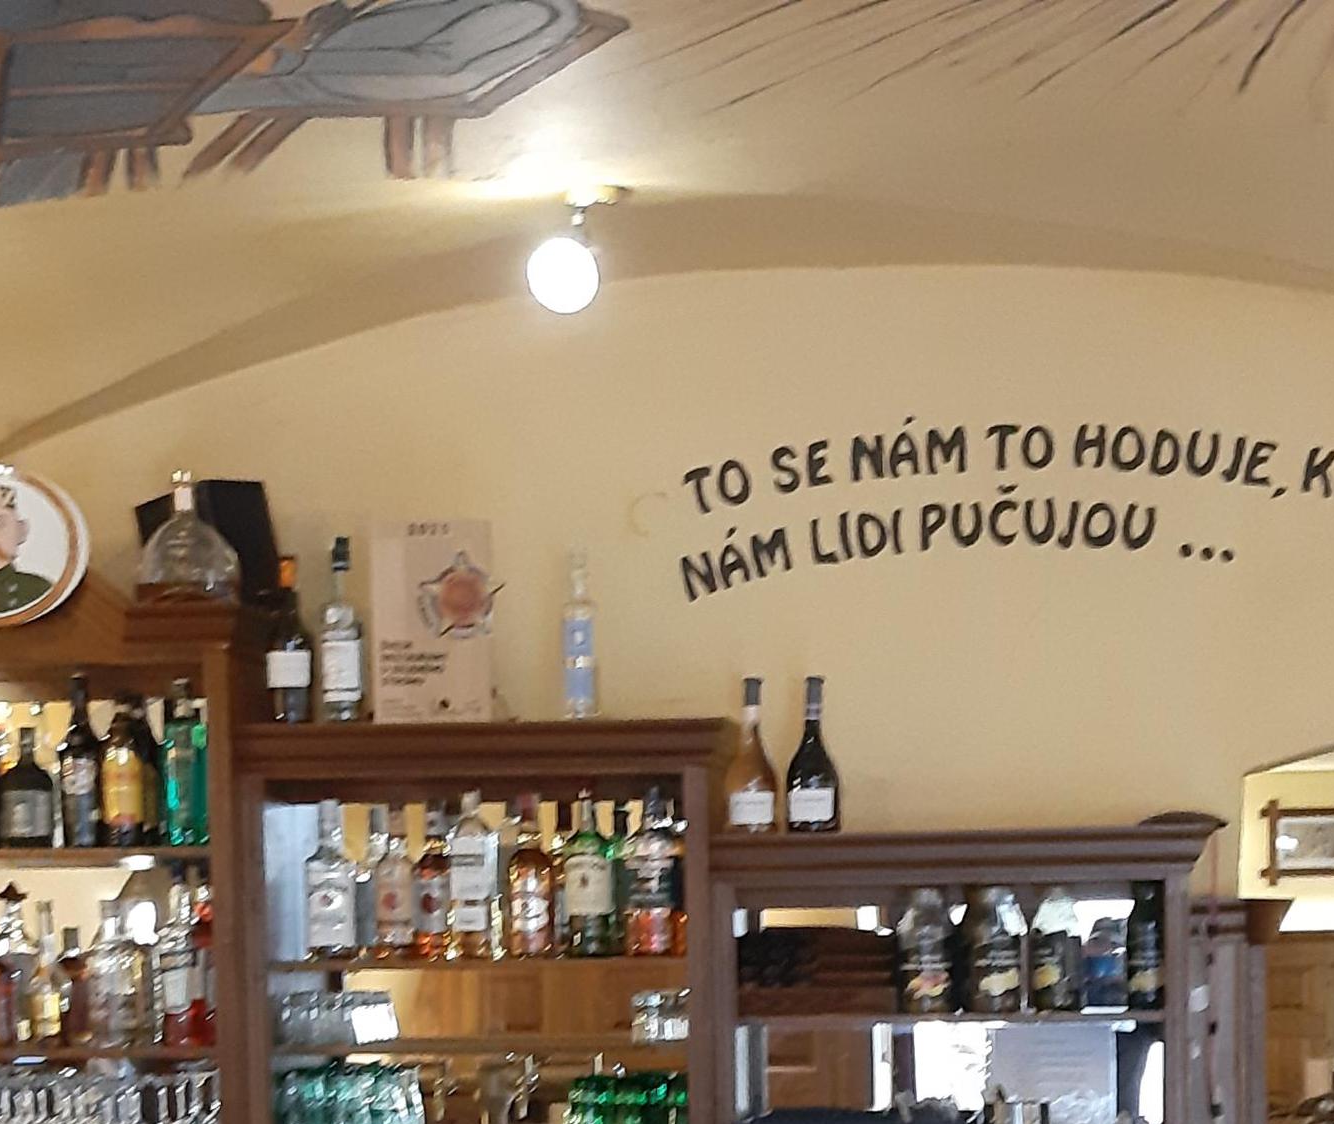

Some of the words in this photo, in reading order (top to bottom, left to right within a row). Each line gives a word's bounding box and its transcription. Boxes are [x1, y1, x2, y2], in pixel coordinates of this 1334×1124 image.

[683, 460, 752, 514] TO
[772, 440, 831, 493] SE
[850, 416, 968, 482] NÁM
[986, 424, 1055, 472] TO
[1073, 423, 1287, 500] HODUJE,
[680, 527, 792, 602] NÁM
[810, 509, 903, 565] LIDI
[919, 484, 1157, 552] PUČUJOU
